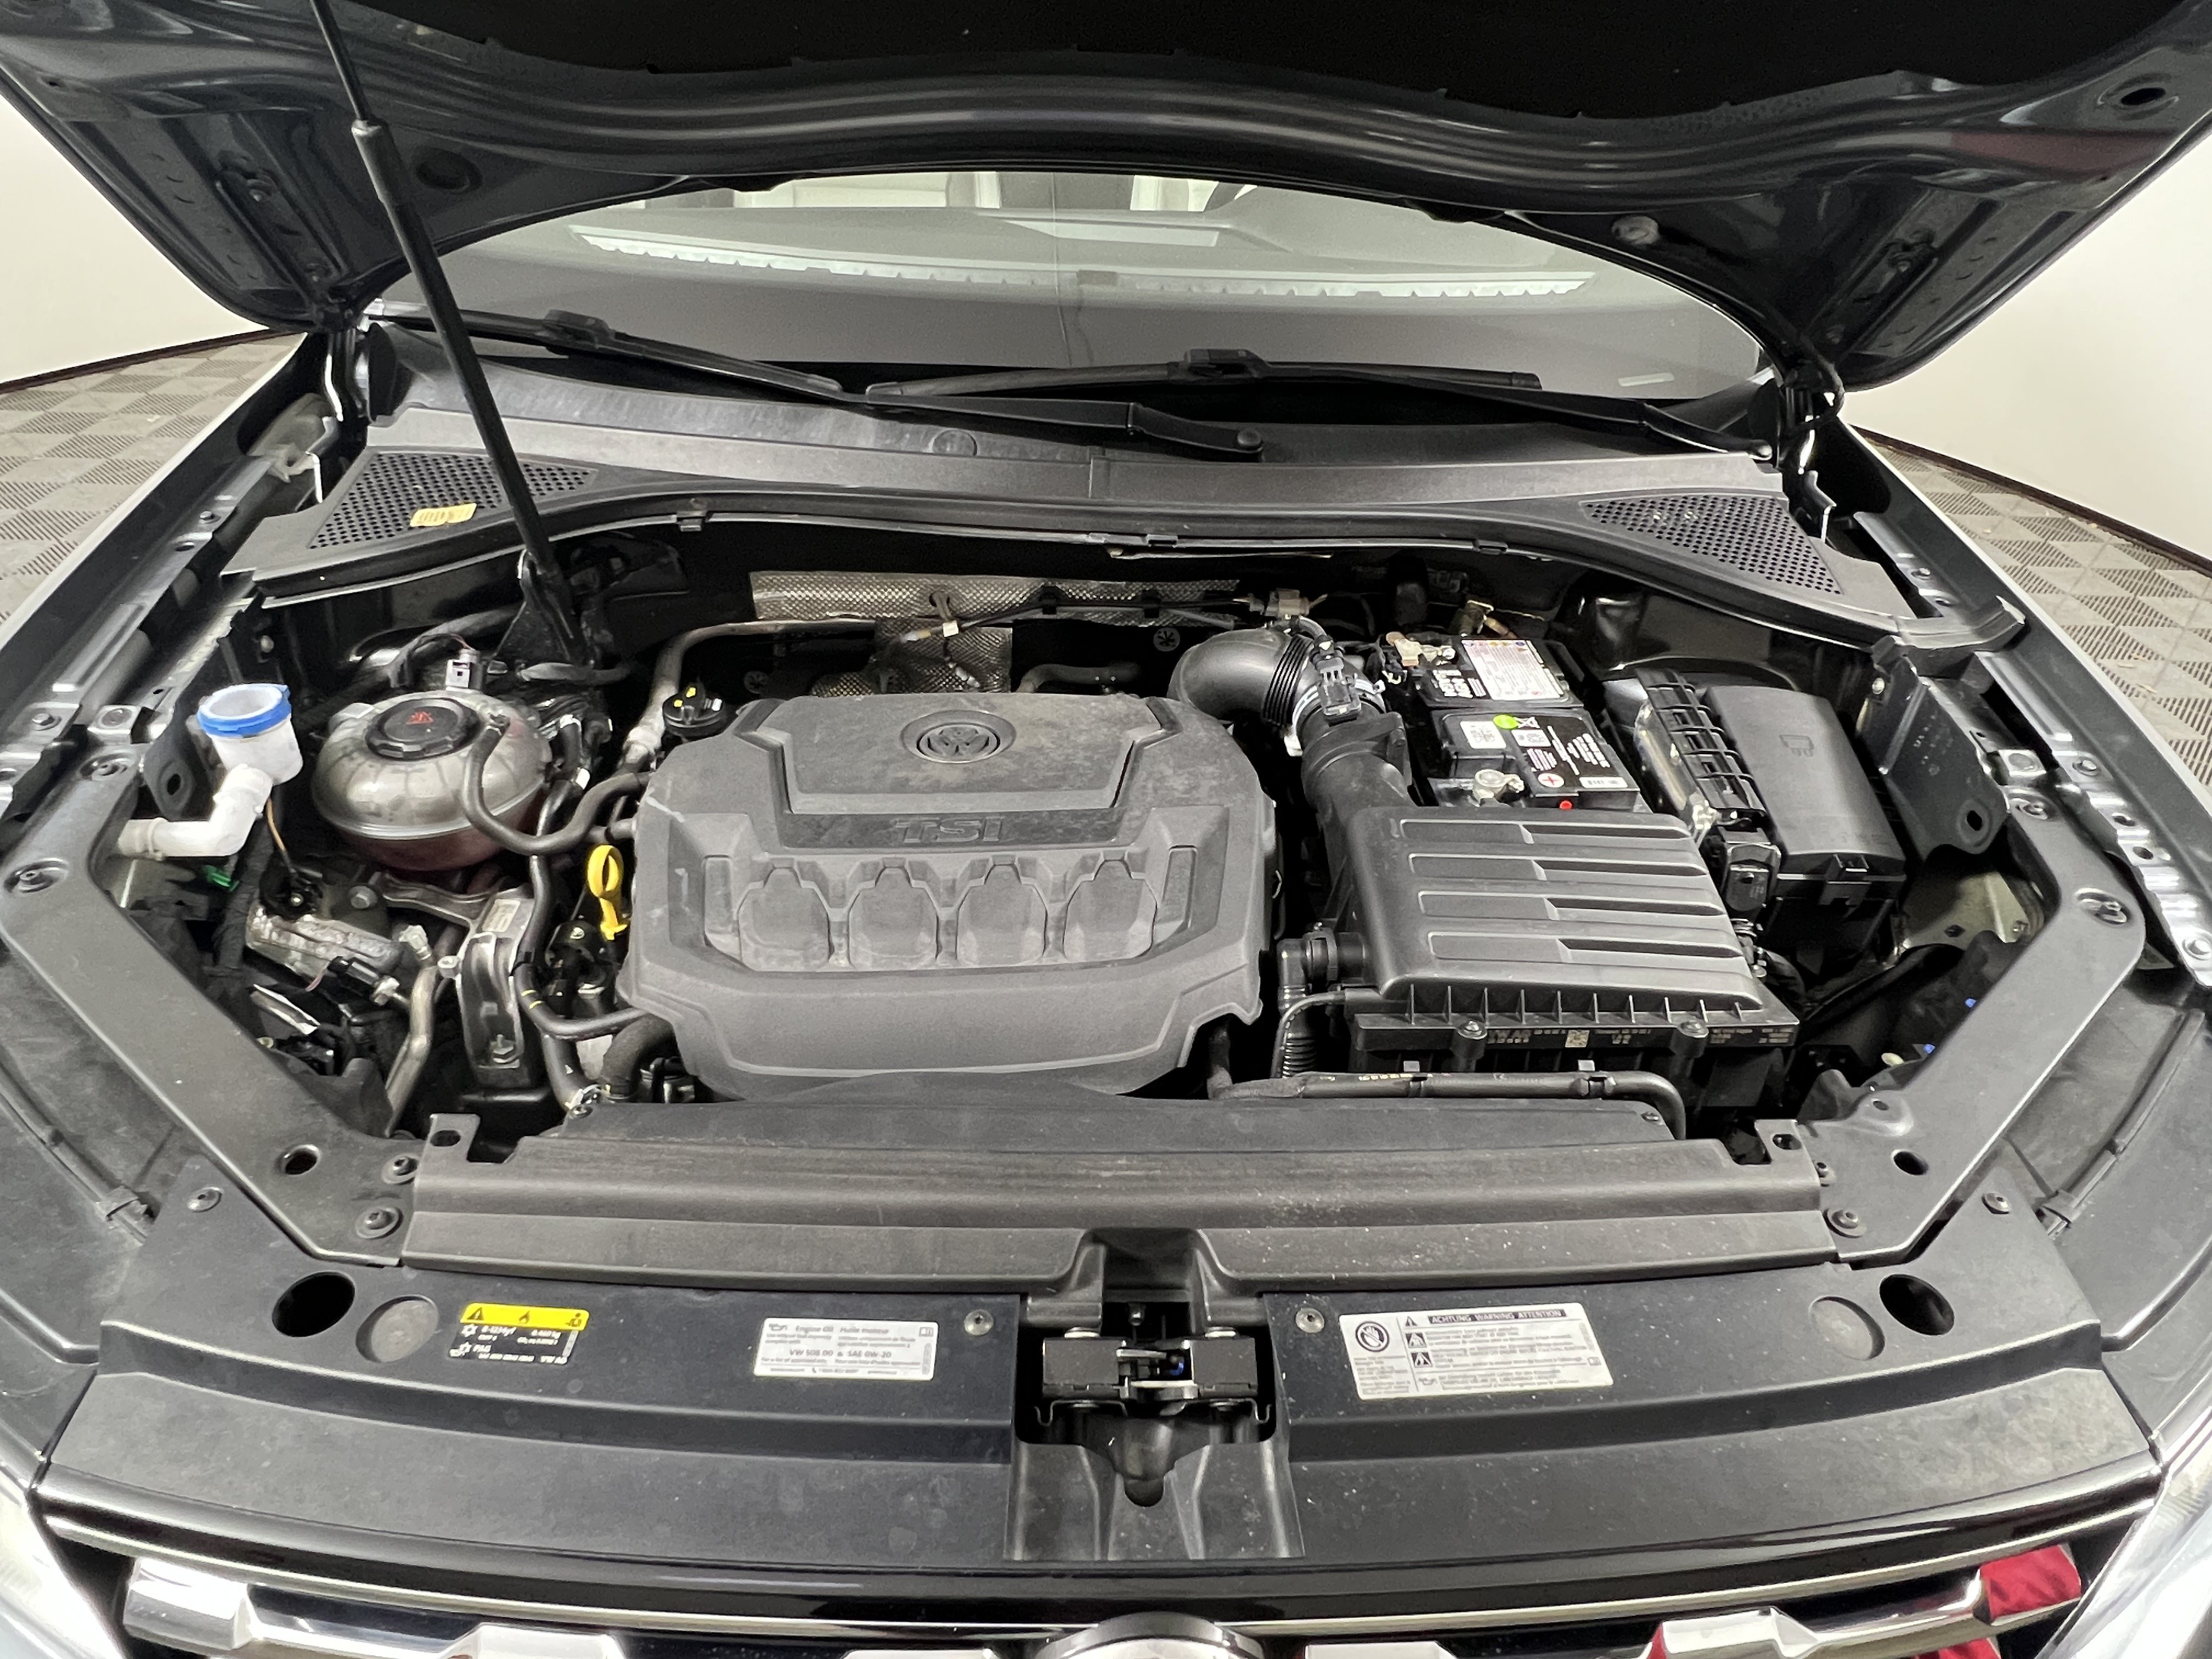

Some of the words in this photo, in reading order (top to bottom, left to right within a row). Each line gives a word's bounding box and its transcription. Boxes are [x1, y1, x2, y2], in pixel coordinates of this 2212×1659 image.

[891, 815, 1006, 843] TSI
[1432, 1314, 1471, 1323] ACHTUNG
[1474, 1312, 1514, 1321] WARNING
[1518, 1310, 1562, 1318] ATTENTION
[796, 1325, 821, 1333] Engine
